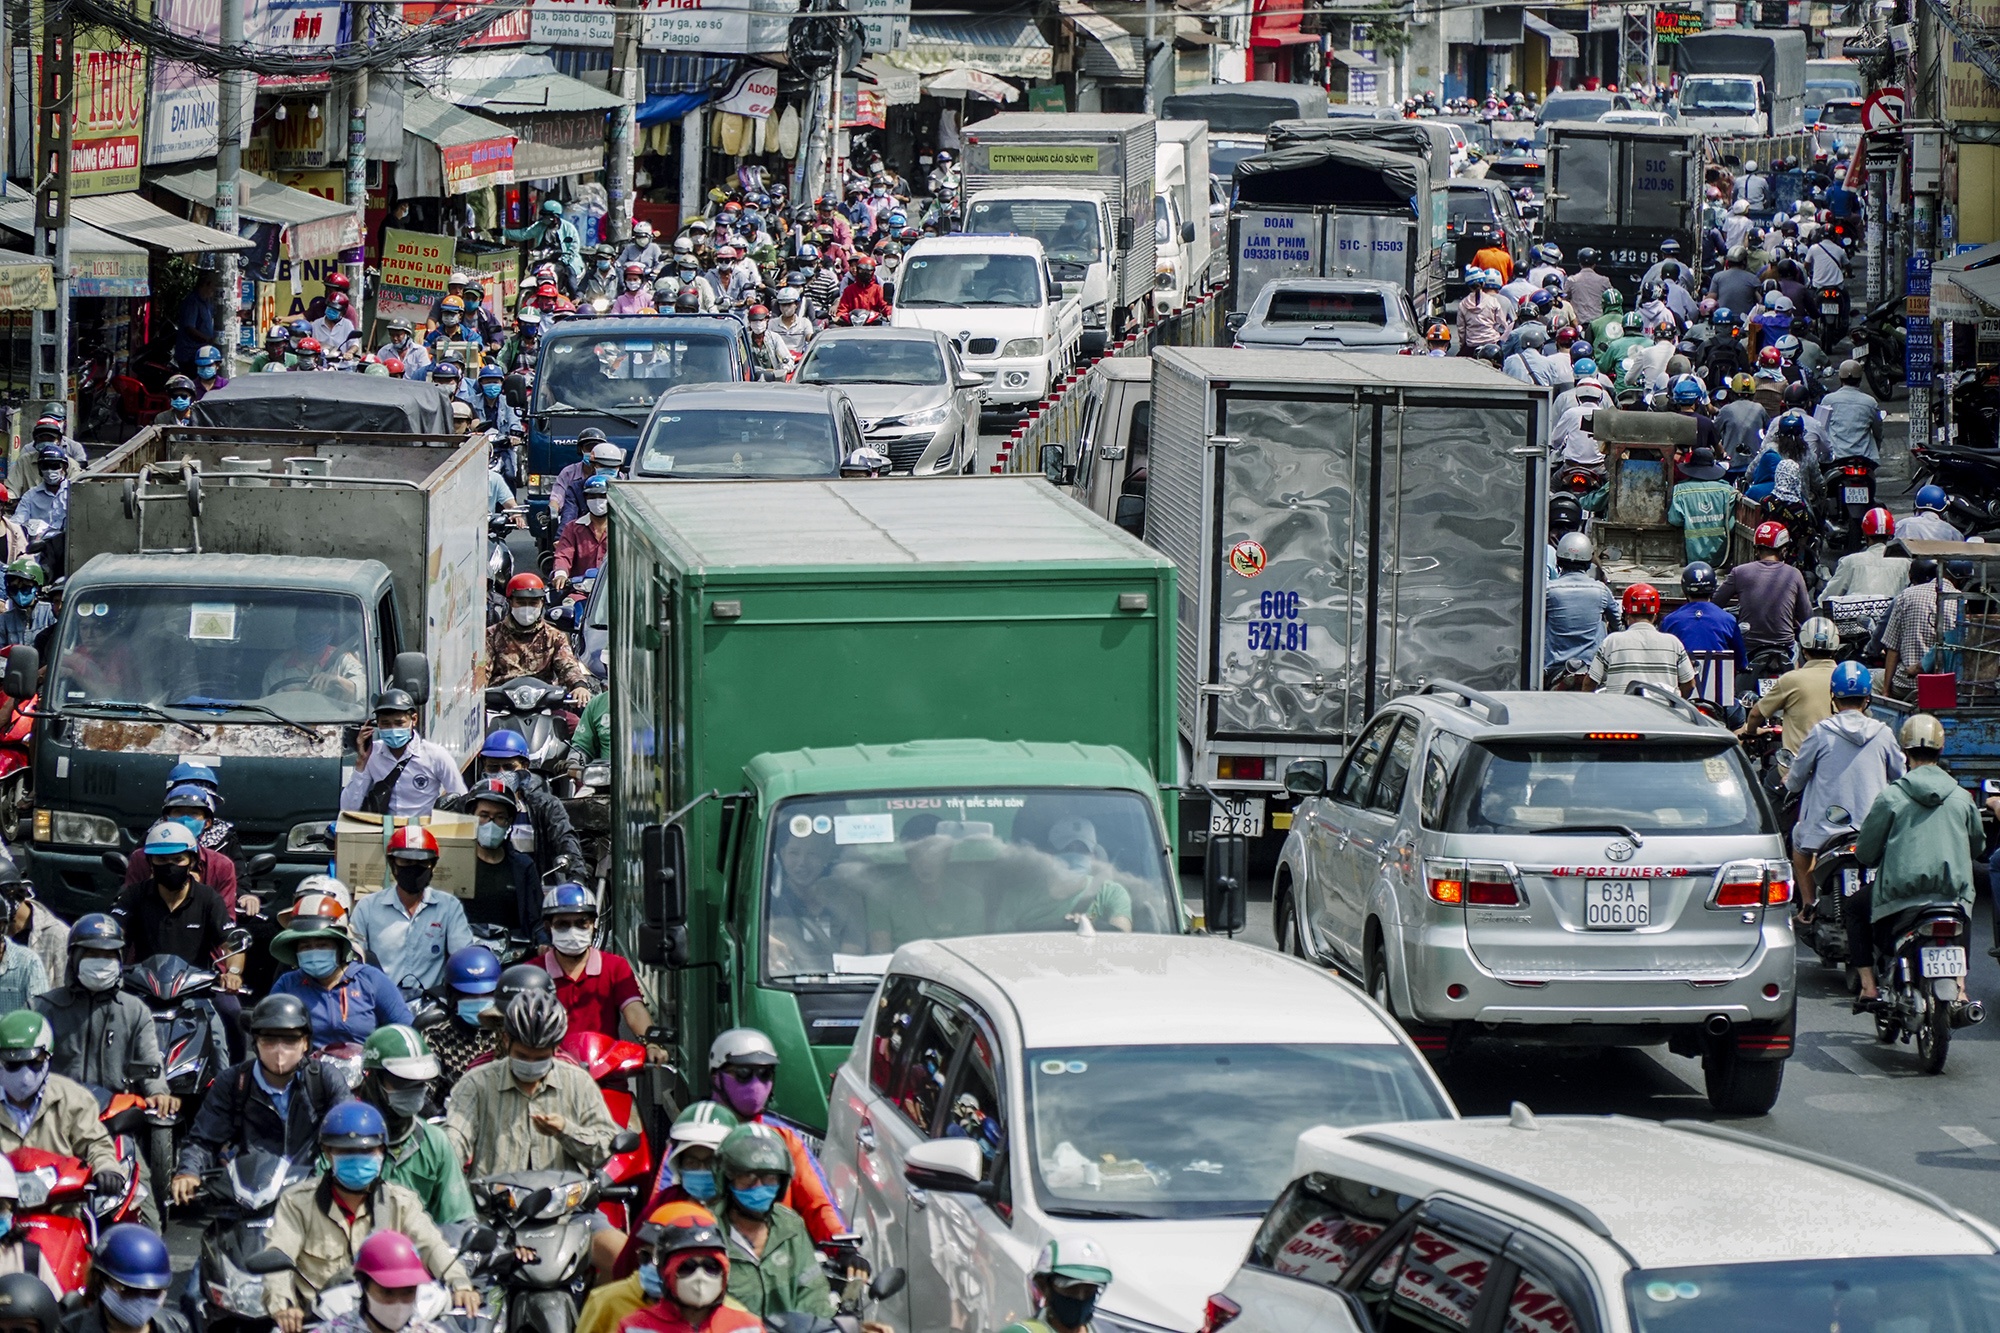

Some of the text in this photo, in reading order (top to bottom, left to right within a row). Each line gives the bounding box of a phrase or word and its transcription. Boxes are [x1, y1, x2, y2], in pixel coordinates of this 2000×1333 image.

[659, 17, 674, 29] tay
[695, 20, 707, 29] xe
[709, 17, 723, 29] số
[863, 23, 881, 32] nda
[541, 26, 579, 37] Yamaha
[589, 28, 613, 38] Suzu
[662, 32, 700, 45] Piaggio
[190, 101, 215, 130] NAM
[993, 155, 1006, 163] CTY
[1007, 155, 1025, 163] TNHH
[1026, 153, 1048, 163] QUẢNG
[1050, 153, 1064, 163] CÁO
[1645, 160, 1666, 173] 51C
[1638, 177, 1674, 191] 120.96
[1277, 237, 1306, 249] PHIM
[1339, 240, 1360, 251] 51C
[1371, 240, 1404, 252] 15503
[422, 245, 439, 258] SỐ
[1243, 248, 1310, 261] 0933816469
[279, 259, 338, 281] BNH
[382, 257, 423, 272] TRÚNG
[1913, 260, 1929, 270] 42
[1910, 353, 1931, 363] 226
[1909, 371, 1932, 382] 31/4
[1260, 590, 1299, 620] 60C
[1247, 621, 1308, 651] 527.81
[886, 800, 942, 809] ISUZU
[1575, 867, 1663, 877] FORTUNER
[1602, 883, 1634, 902] 63A
[1589, 904, 1647, 924] 006.06
[1926, 964, 1963, 975] 151.07
